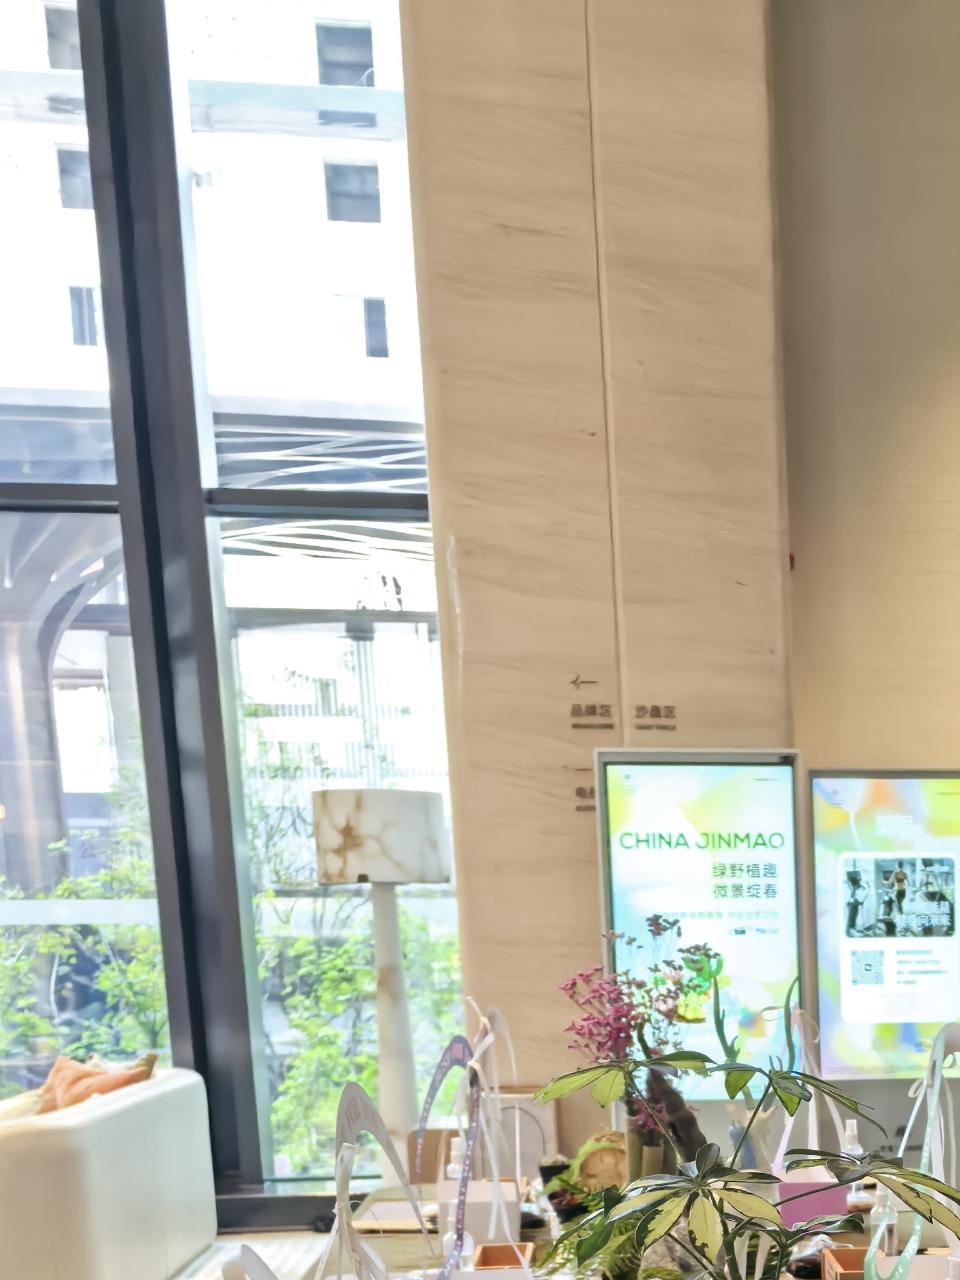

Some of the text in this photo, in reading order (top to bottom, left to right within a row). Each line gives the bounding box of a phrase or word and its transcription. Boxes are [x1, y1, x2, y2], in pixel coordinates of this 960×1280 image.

[619, 832, 785, 849] CHINA JINMAO
[711, 863, 779, 879] 绿野植趣
[712, 884, 779, 899] 微景绽春
